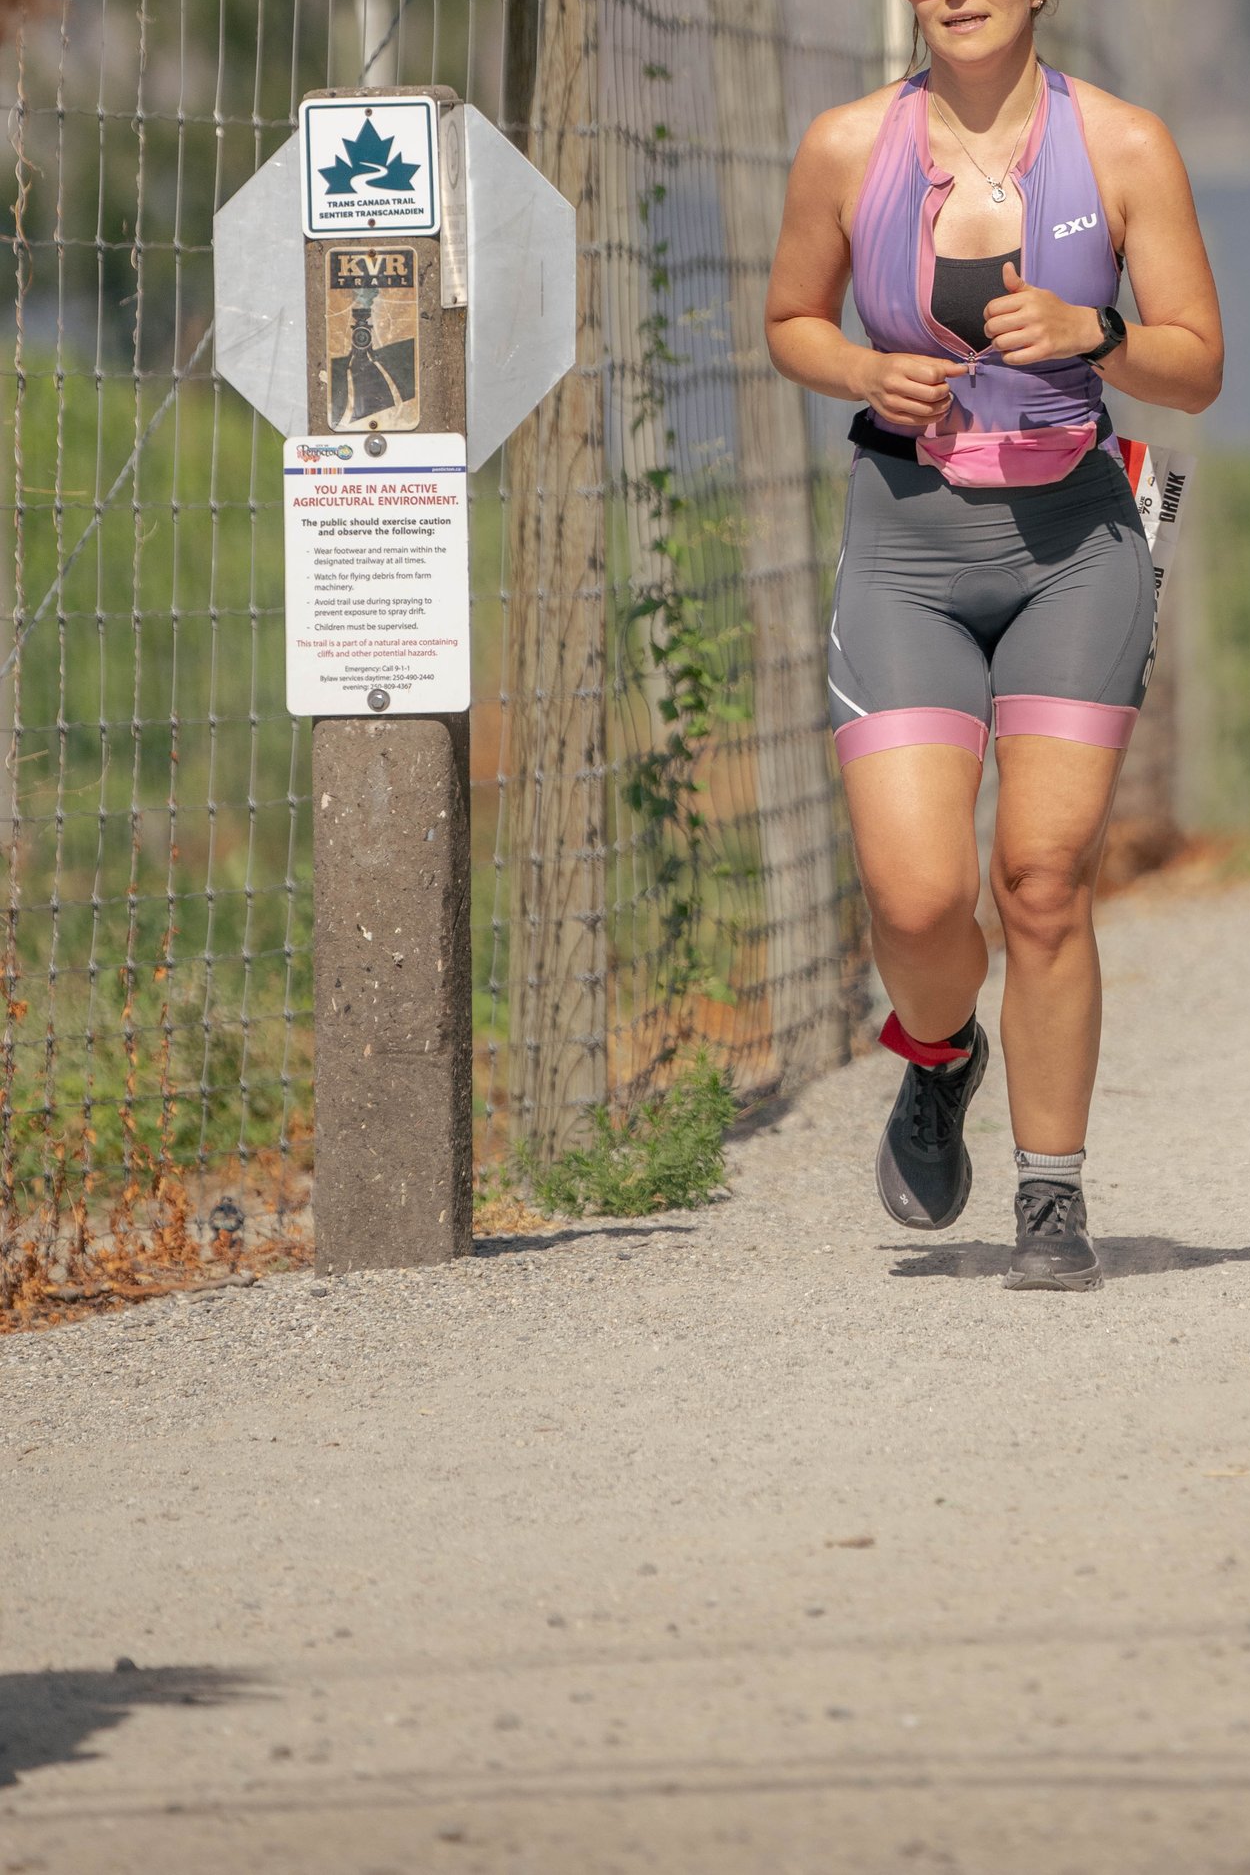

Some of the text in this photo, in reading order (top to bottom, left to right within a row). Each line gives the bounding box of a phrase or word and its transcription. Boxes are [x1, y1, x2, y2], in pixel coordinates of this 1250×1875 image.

[327, 199, 355, 208] TRANS
[319, 207, 424, 219] SENTIER TRANSCANADIEN
[1052, 212, 1098, 240] 2XU
[338, 254, 407, 276] KVR
[337, 278, 408, 286] TRAIL
[297, 444, 338, 457] Penticton
[314, 484, 437, 494] YOU ARE IN AN ACTIVE
[293, 495, 459, 507] AGRICULTURAL ENVIRONMENT.
[1158, 471, 1186, 523] DRINK
[1142, 498, 1152, 514] 70
[320, 518, 346, 528] public
[392, 527, 435, 536] following:
[314, 557, 354, 567] designated
[356, 557, 384, 566] trailway
[350, 572, 370, 582] flying
[314, 583, 354, 592] machinery.
[367, 597, 390, 607] during
[392, 598, 423, 607] spraying
[314, 609, 343, 618] prevent
[378, 622, 418, 632] supervised.
[419, 638, 458, 647] containing
[373, 650, 406, 658] potential
[365, 674, 391, 683] daytime:
